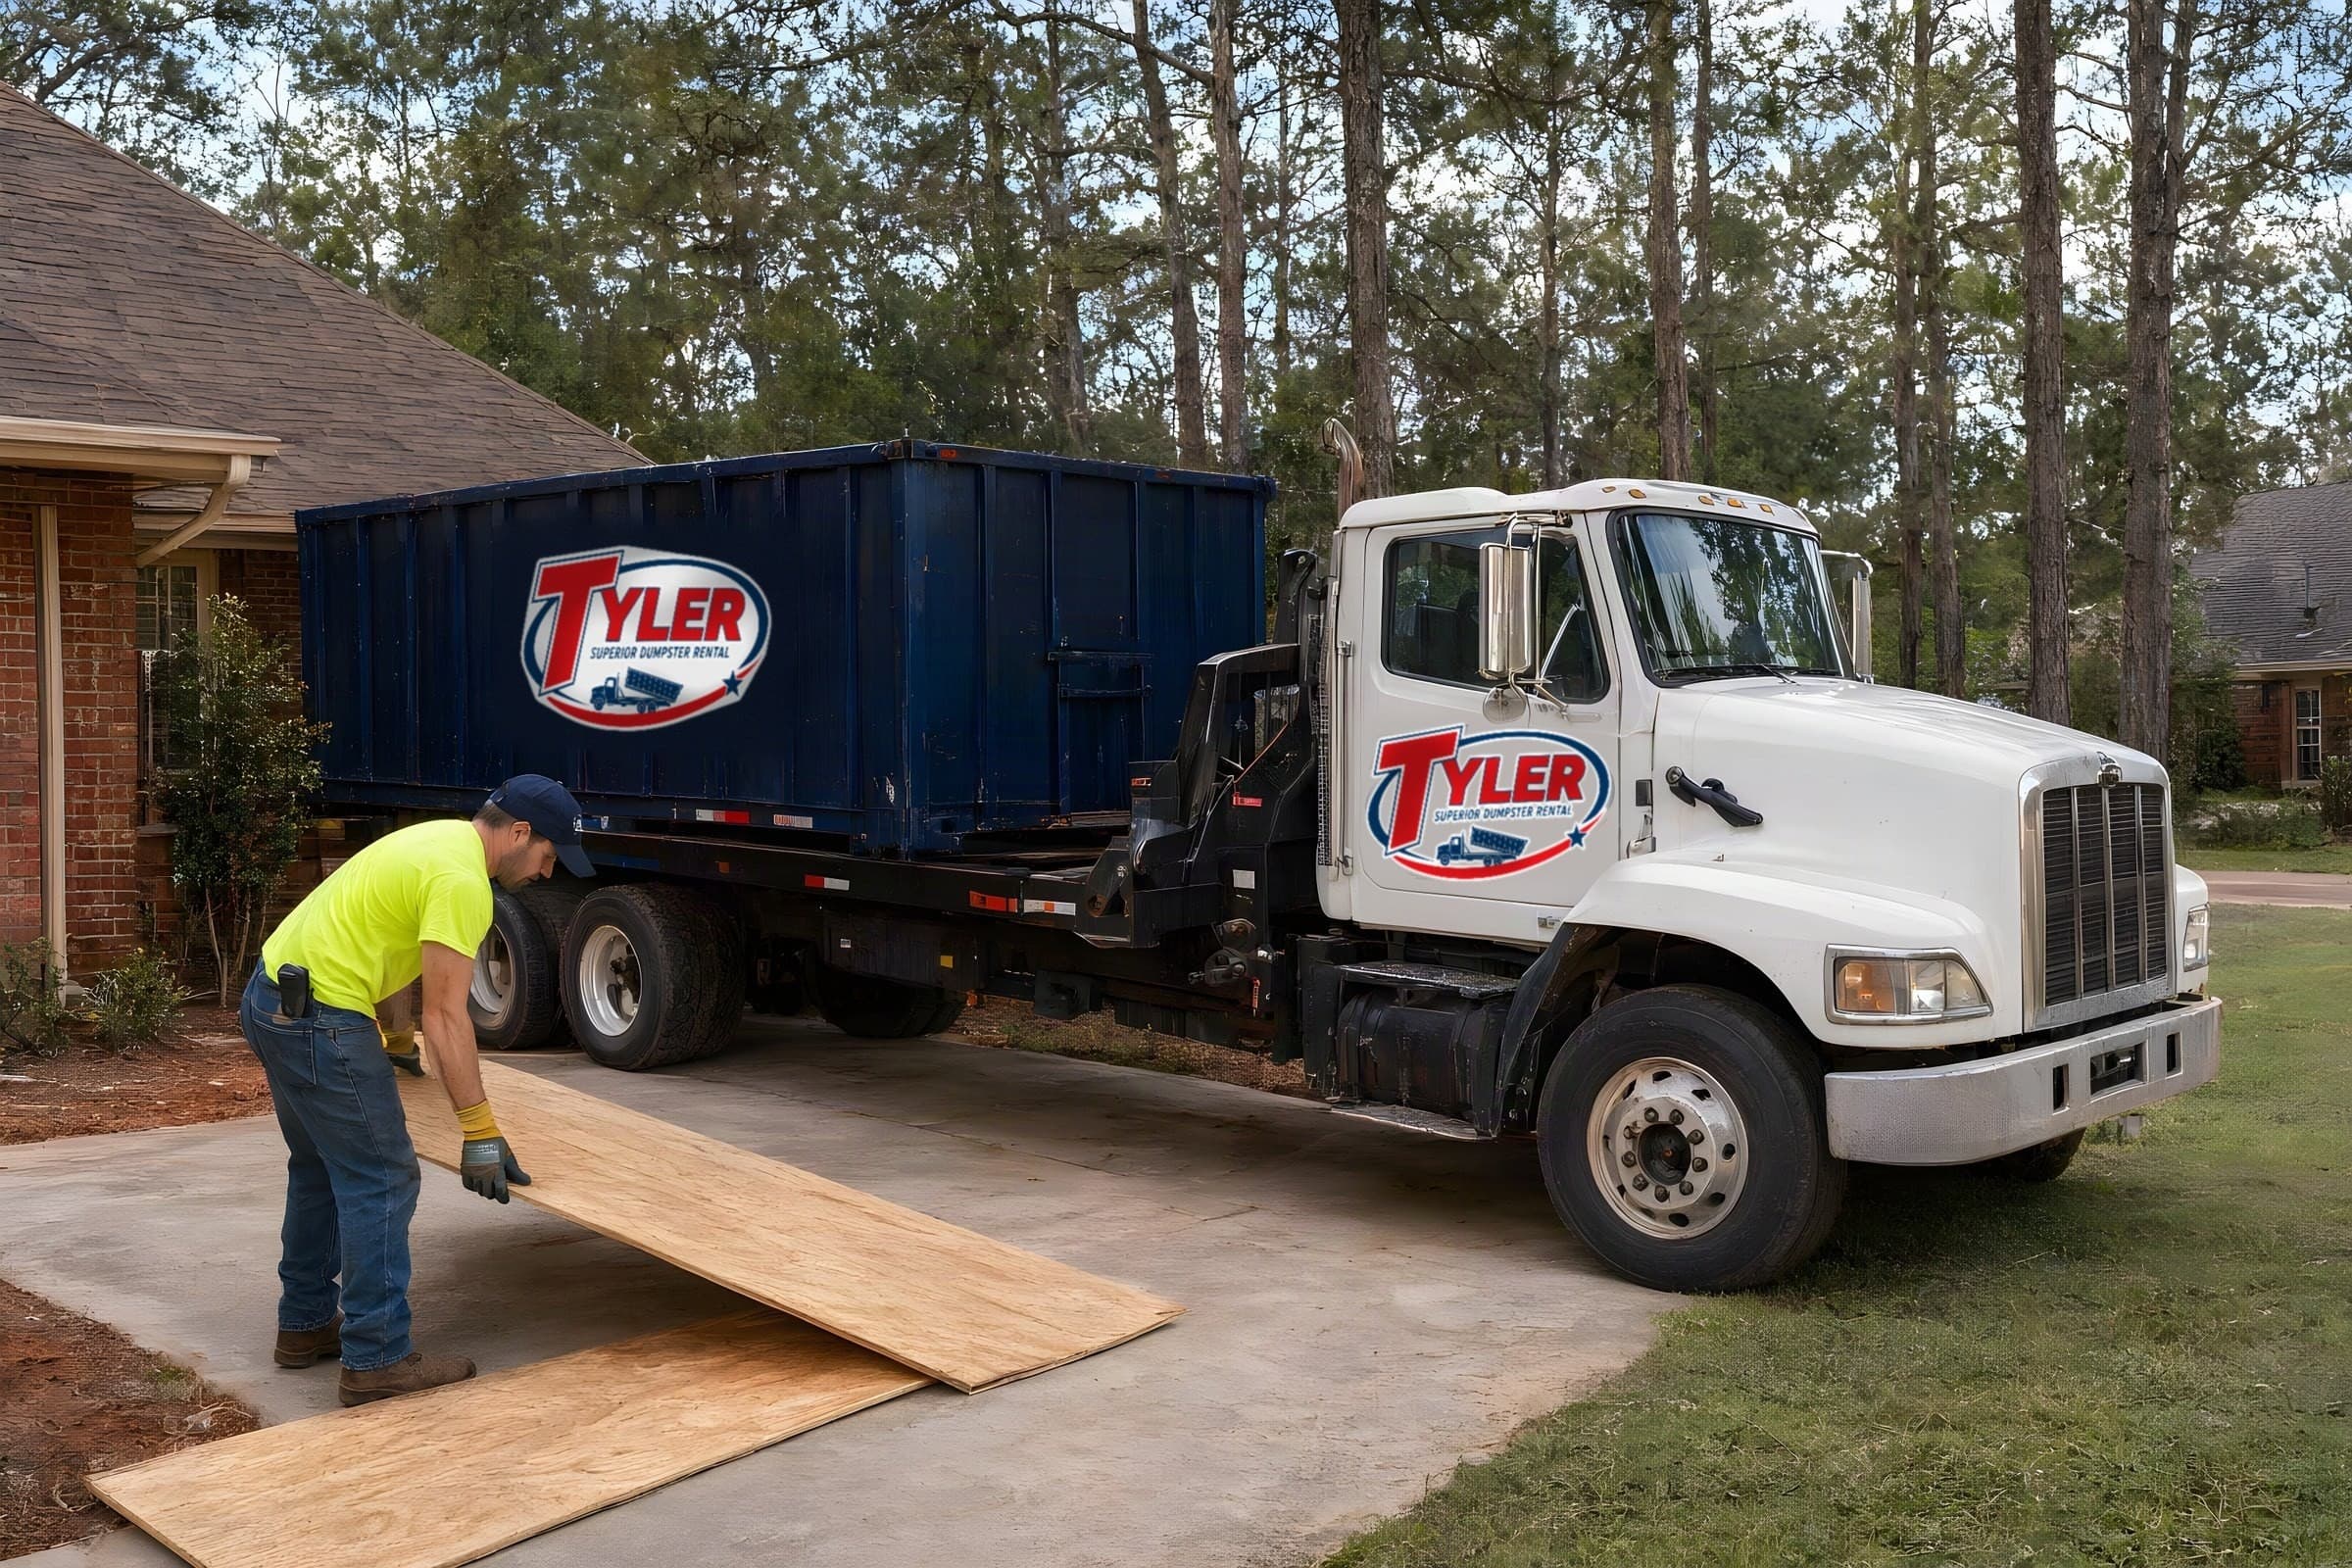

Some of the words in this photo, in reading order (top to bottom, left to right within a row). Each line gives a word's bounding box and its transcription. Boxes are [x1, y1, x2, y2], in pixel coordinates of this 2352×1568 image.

[533, 551, 746, 695] TYLER
[590, 646, 637, 660] SUPERIOR
[639, 646, 690, 659] DUMPSTER
[692, 646, 730, 659] RENTAL
[1374, 725, 1587, 855] TYLER
[1434, 808, 1481, 822] SUPERIOR
[1483, 806, 1533, 819] DUMPSTER
[1536, 805, 1572, 816] RENTAL
